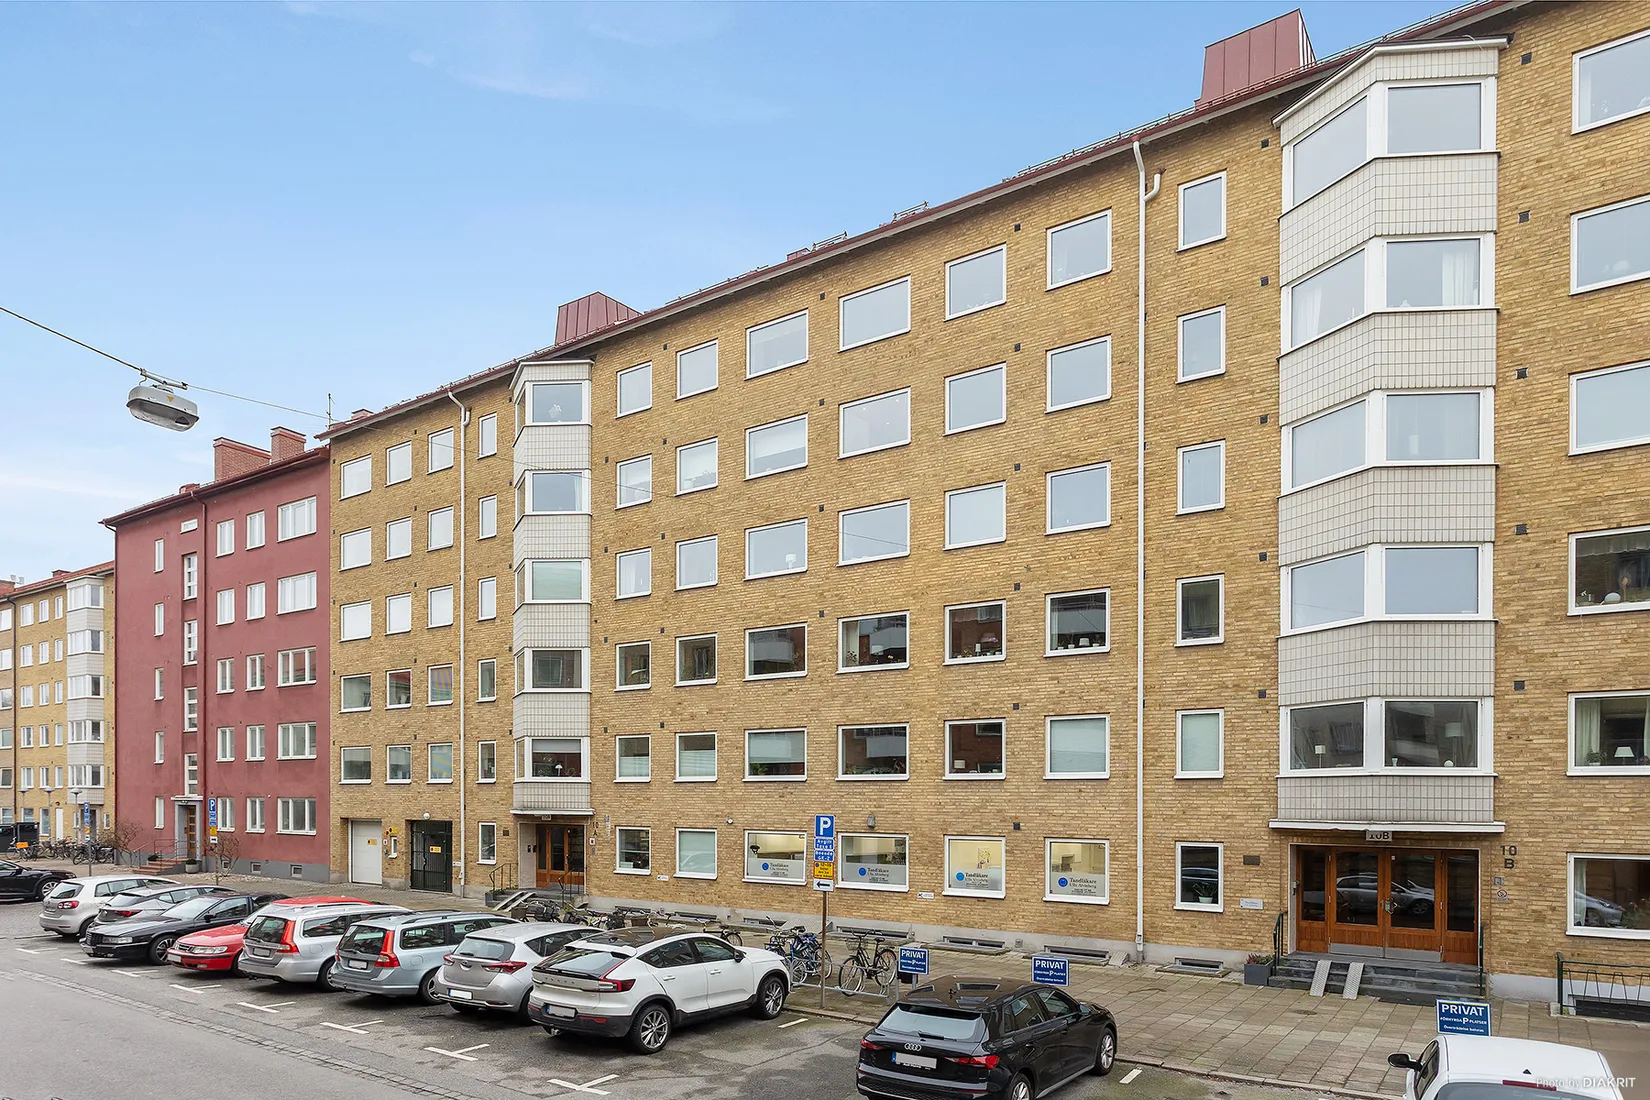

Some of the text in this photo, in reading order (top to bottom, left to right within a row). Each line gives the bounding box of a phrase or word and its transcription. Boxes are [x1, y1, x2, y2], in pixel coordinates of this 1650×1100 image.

[820, 817, 831, 835] P
[1500, 845, 1517, 856] 10
[1504, 859, 1515, 869] B
[902, 950, 925, 959] PRIVAT
[1036, 960, 1064, 969] PRIVAT
[1441, 1004, 1484, 1016] PRIVAT
